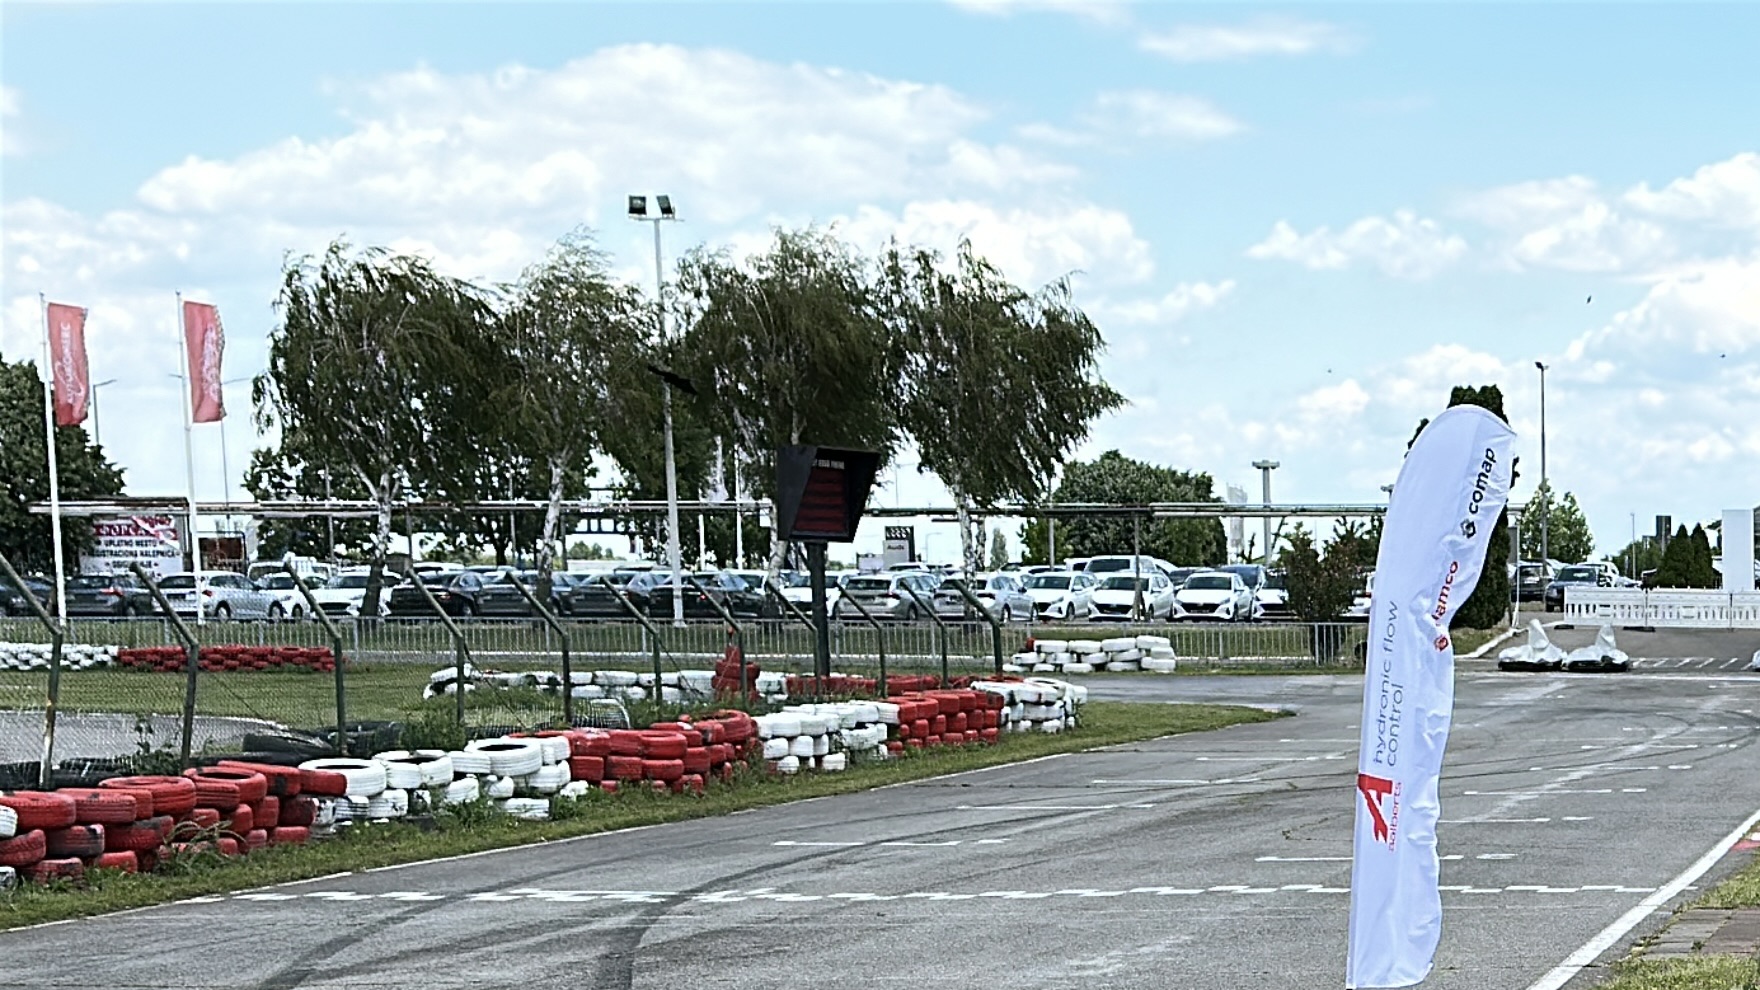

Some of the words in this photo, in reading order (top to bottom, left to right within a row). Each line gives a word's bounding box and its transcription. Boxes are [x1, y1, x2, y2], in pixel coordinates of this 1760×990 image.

[1468, 447, 1497, 515] comap
[1372, 659, 1393, 765] hydronic
[1383, 600, 1399, 653] flow
[1386, 683, 1405, 767] control
